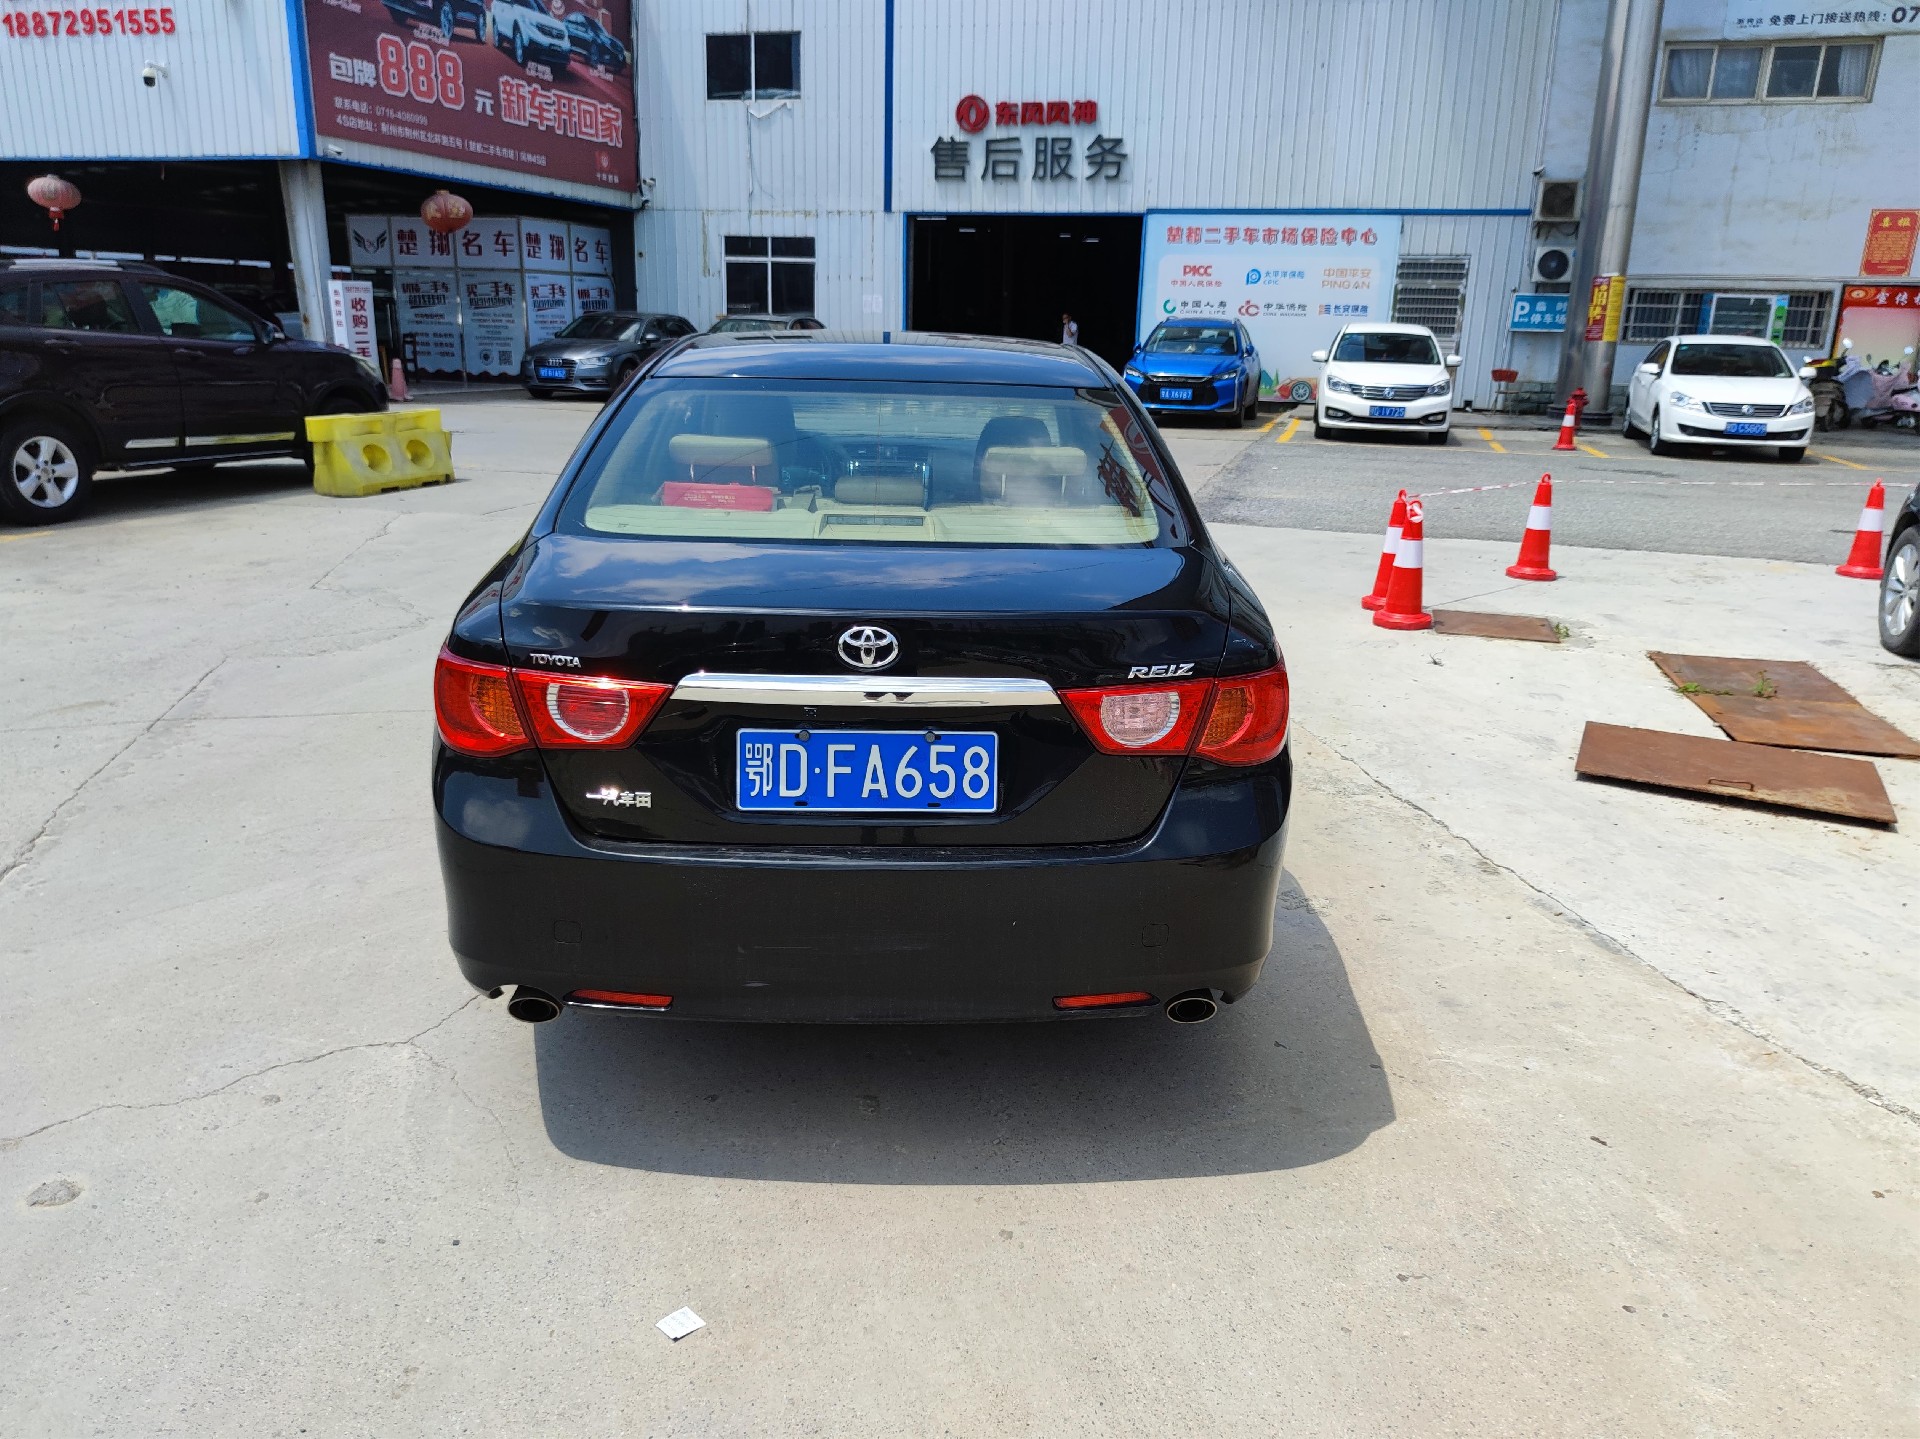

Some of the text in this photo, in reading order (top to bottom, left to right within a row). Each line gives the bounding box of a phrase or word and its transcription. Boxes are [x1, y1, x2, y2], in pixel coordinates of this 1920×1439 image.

[3, 7, 176, 38] 18872951555
[1891, 6, 1920, 23] 07
[329, 52, 377, 88] 包牌
[377, 33, 464, 111] 888
[475, 88, 494, 116] 元
[499, 75, 623, 148] 新车开回家
[995, 100, 1098, 126] 东风风神
[930, 133, 1128, 182] 售后服务
[1167, 226, 1378, 246] 楚都二手车市场保险中心
[525, 232, 609, 265] 楚翔名车
[1183, 265, 1213, 277] PICC
[1263, 270, 1305, 279] 太平洋保险
[1323, 268, 1372, 278] 中国平安
[1170, 280, 1222, 288] 中国人民保险
[1321, 280, 1351, 290] PING
[1180, 300, 1227, 310] 中国人寿
[529, 652, 582, 668] TOYOTA
[1127, 663, 1195, 679] REIZ
[745, 743, 990, 799] 鄂D·FA658
